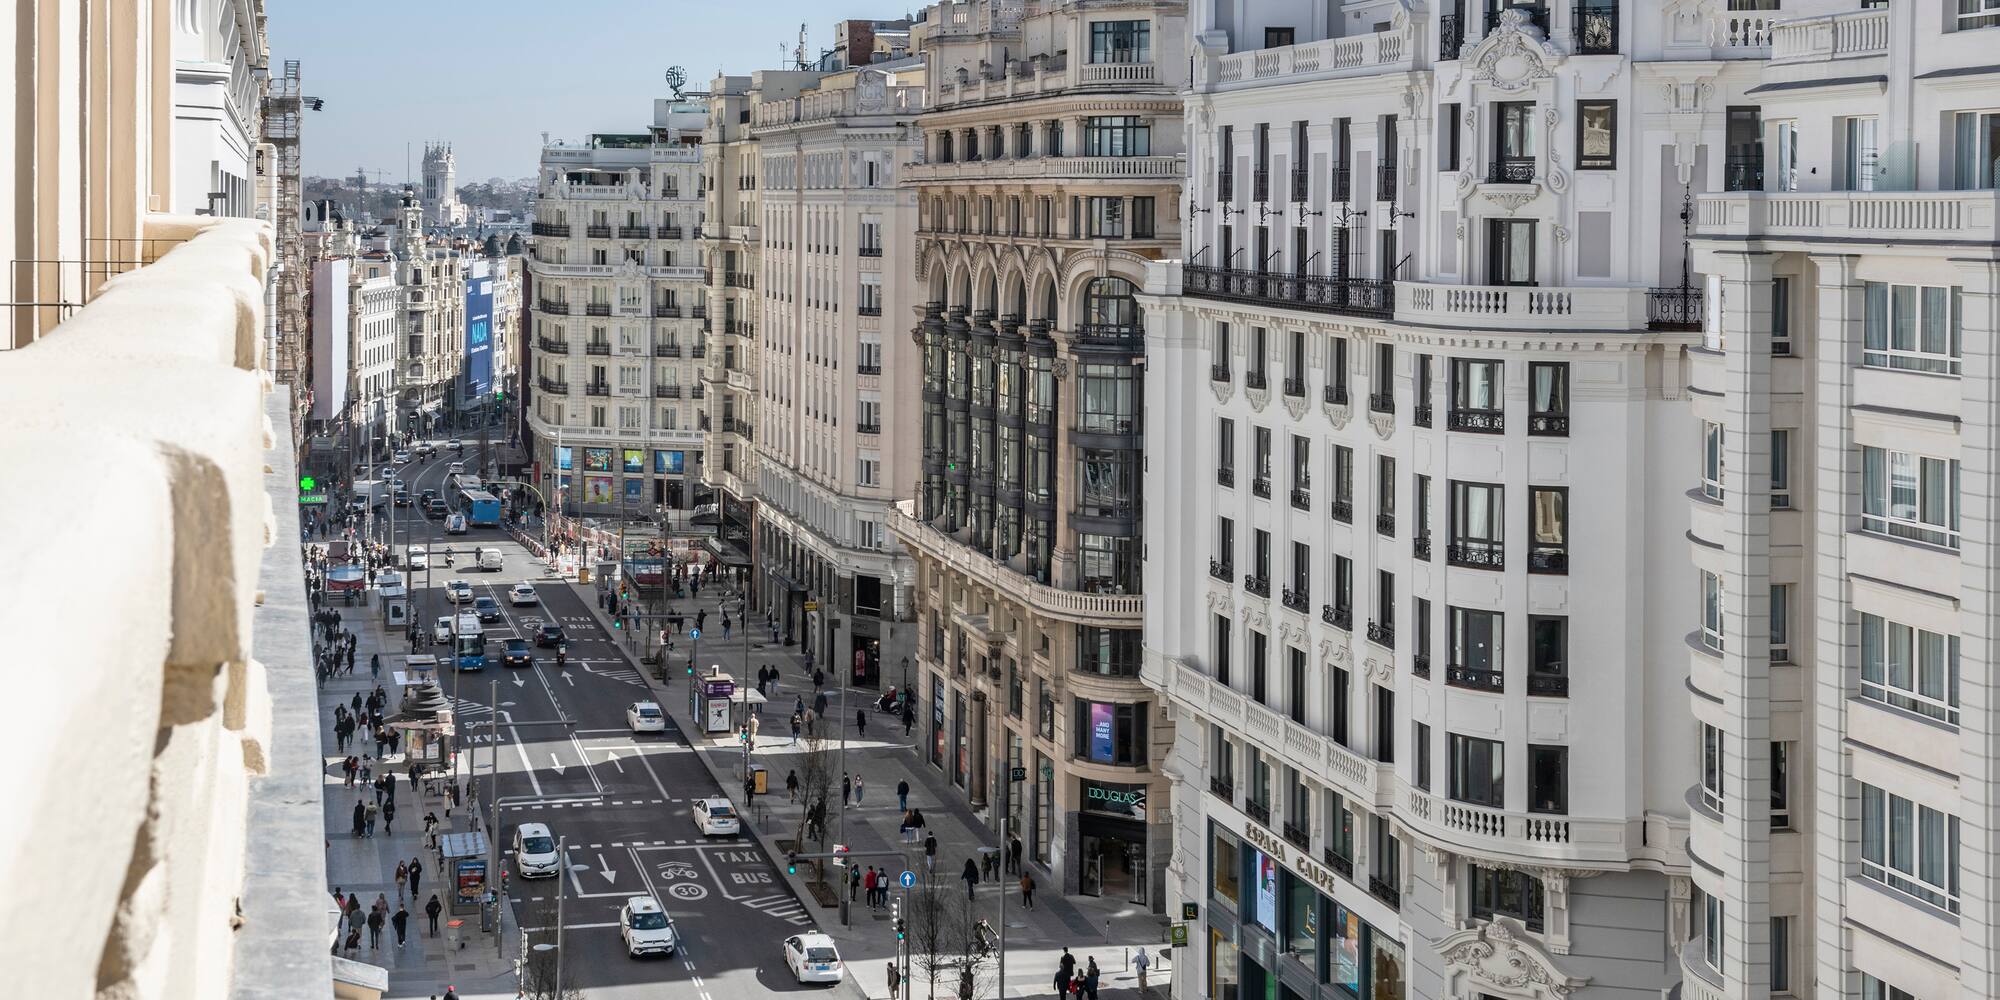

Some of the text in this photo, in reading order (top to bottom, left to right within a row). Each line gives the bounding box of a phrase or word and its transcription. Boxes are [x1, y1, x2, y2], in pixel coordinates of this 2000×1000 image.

[472, 321, 488, 344] NADA
[465, 734, 504, 743] TAXI
[1088, 787, 1137, 804] DOUGLAS
[714, 851, 762, 862] TAXI
[1246, 822, 1335, 894] ESPASA CALPE
[730, 872, 772, 884] BUS
[677, 887, 699, 895] 30
